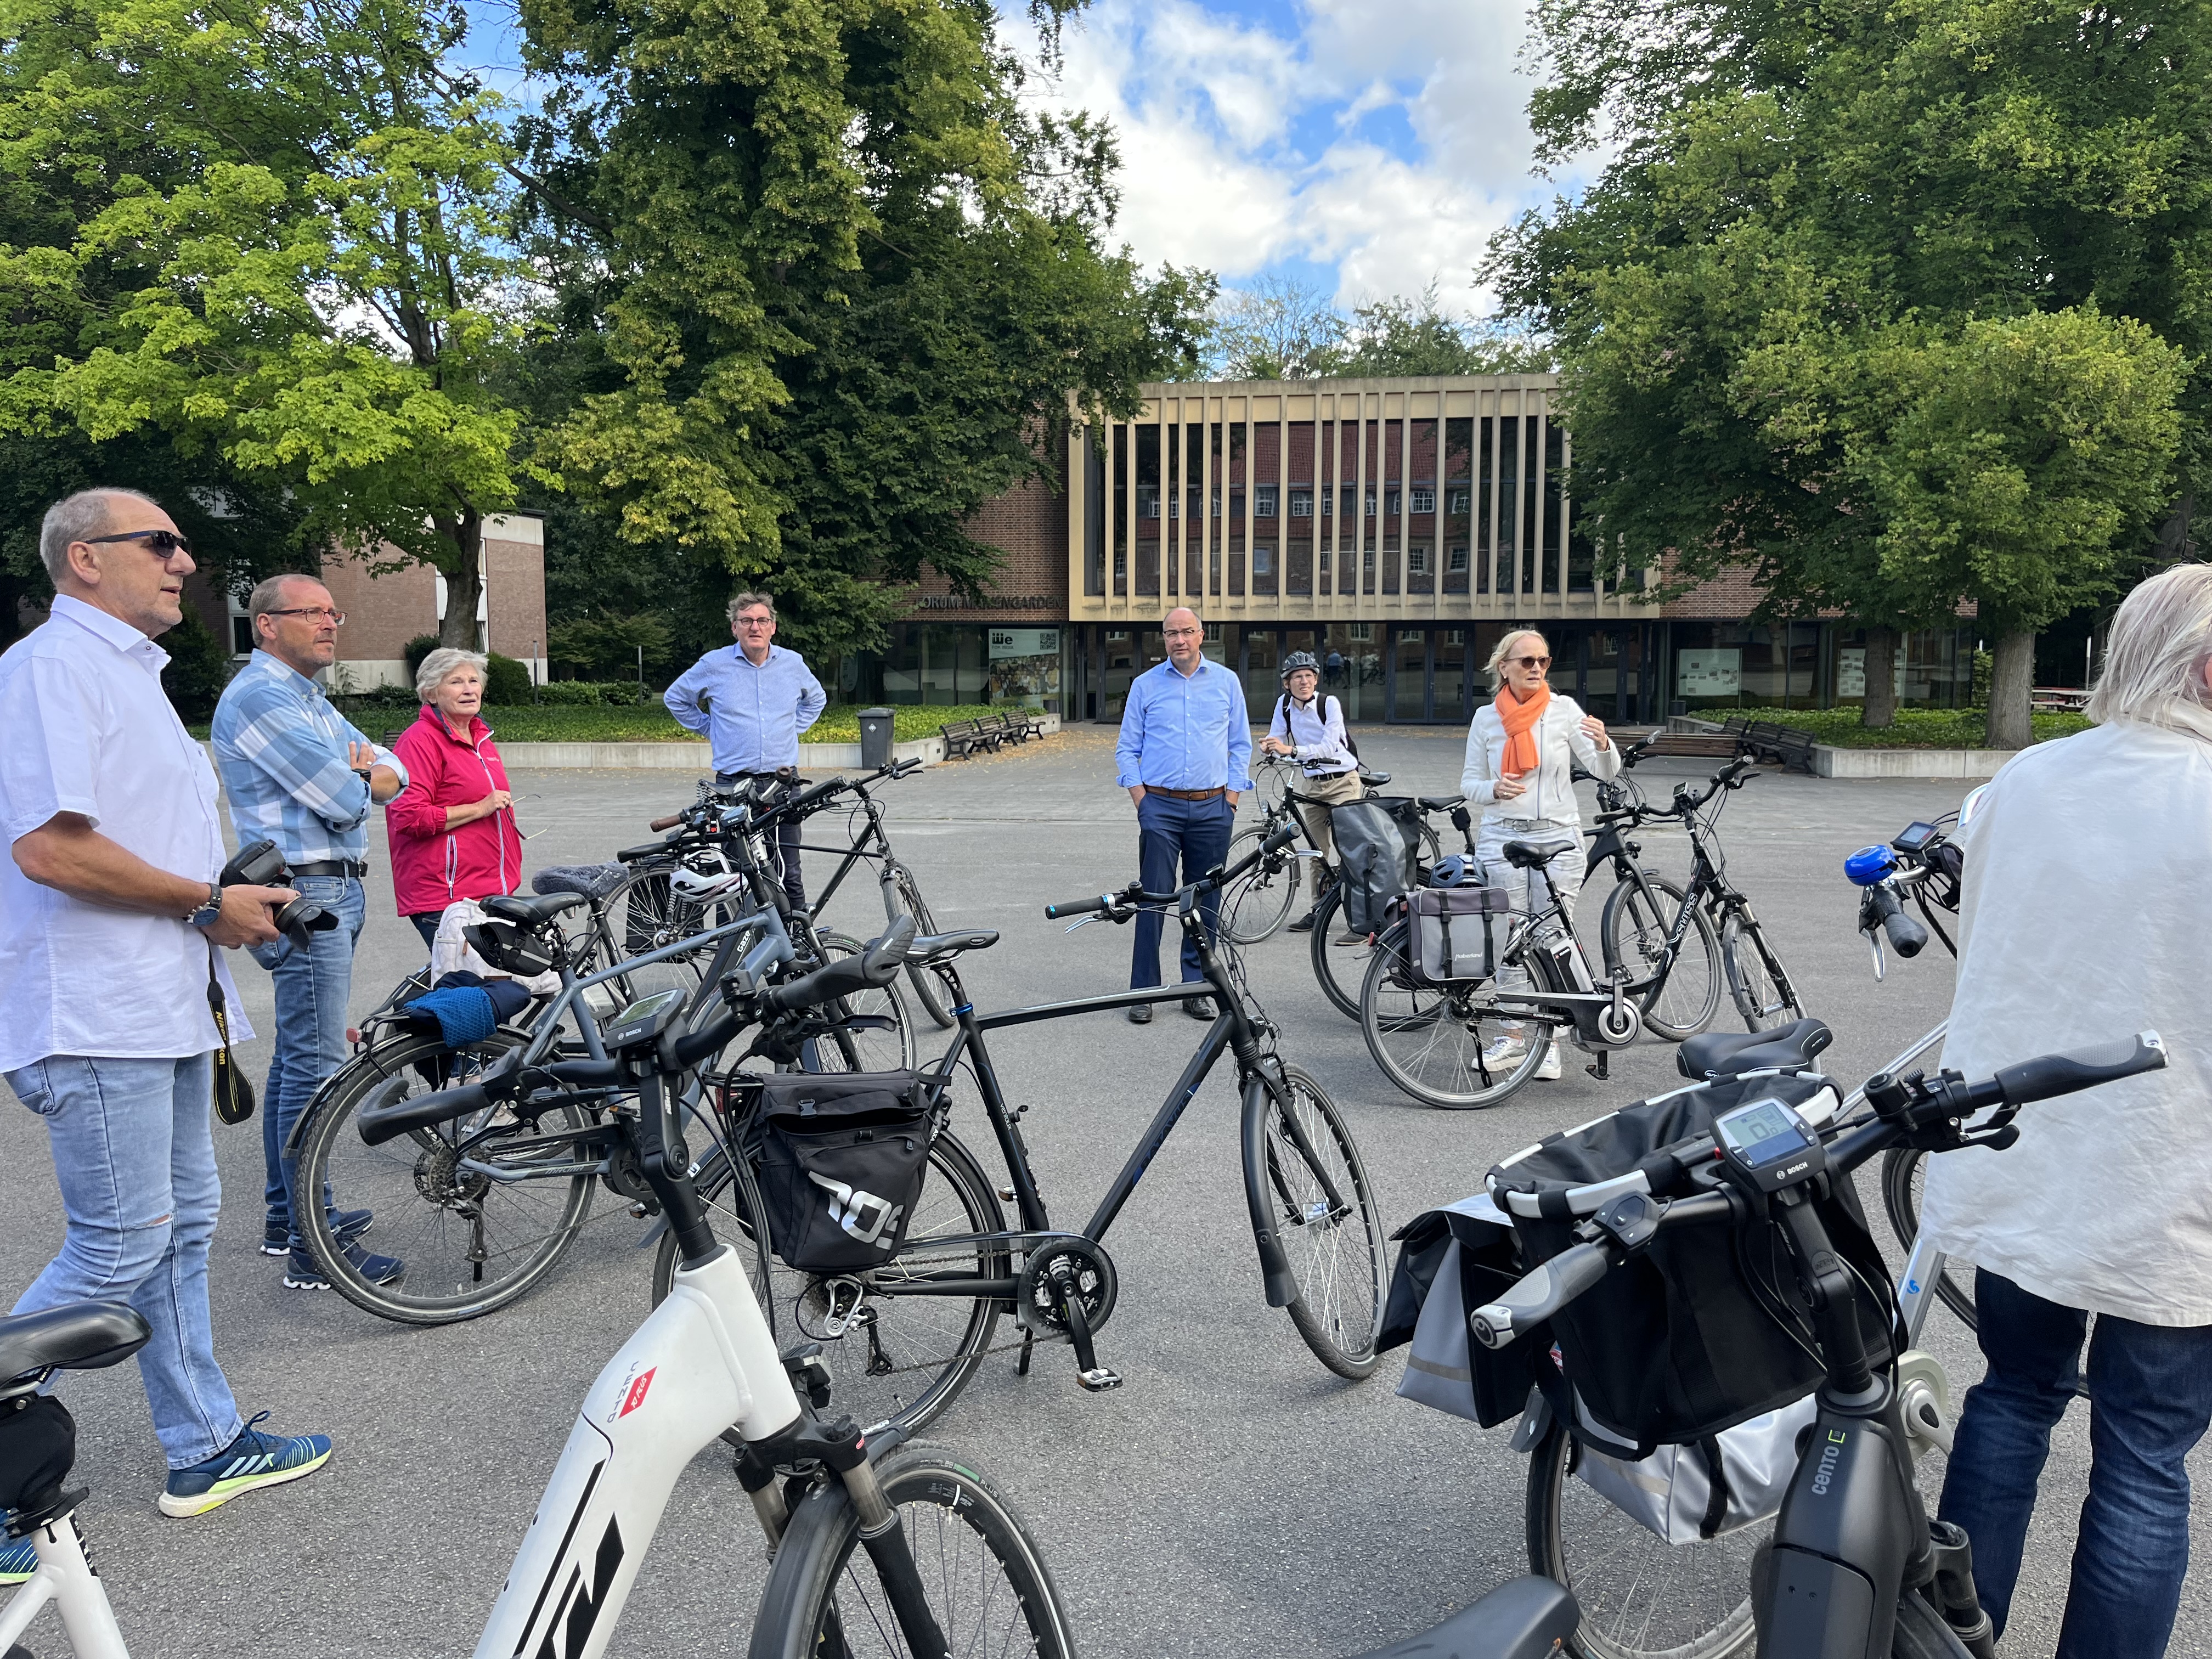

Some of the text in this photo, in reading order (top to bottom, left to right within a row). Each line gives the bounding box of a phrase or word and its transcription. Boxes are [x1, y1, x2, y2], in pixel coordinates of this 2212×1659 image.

[916, 595, 1063, 609] FORUM MRIENGARDEN
[737, 929, 751, 952] Gaze
[625, 1028, 642, 1037] BOSCH
[1786, 1161, 1808, 1175] BOSCH
[607, 1361, 639, 1423] CENTO
[636, 1375, 647, 1399] PLUS
[908, 1405, 938, 1431] SCHWALB
[980, 1479, 998, 1498] PLUS
